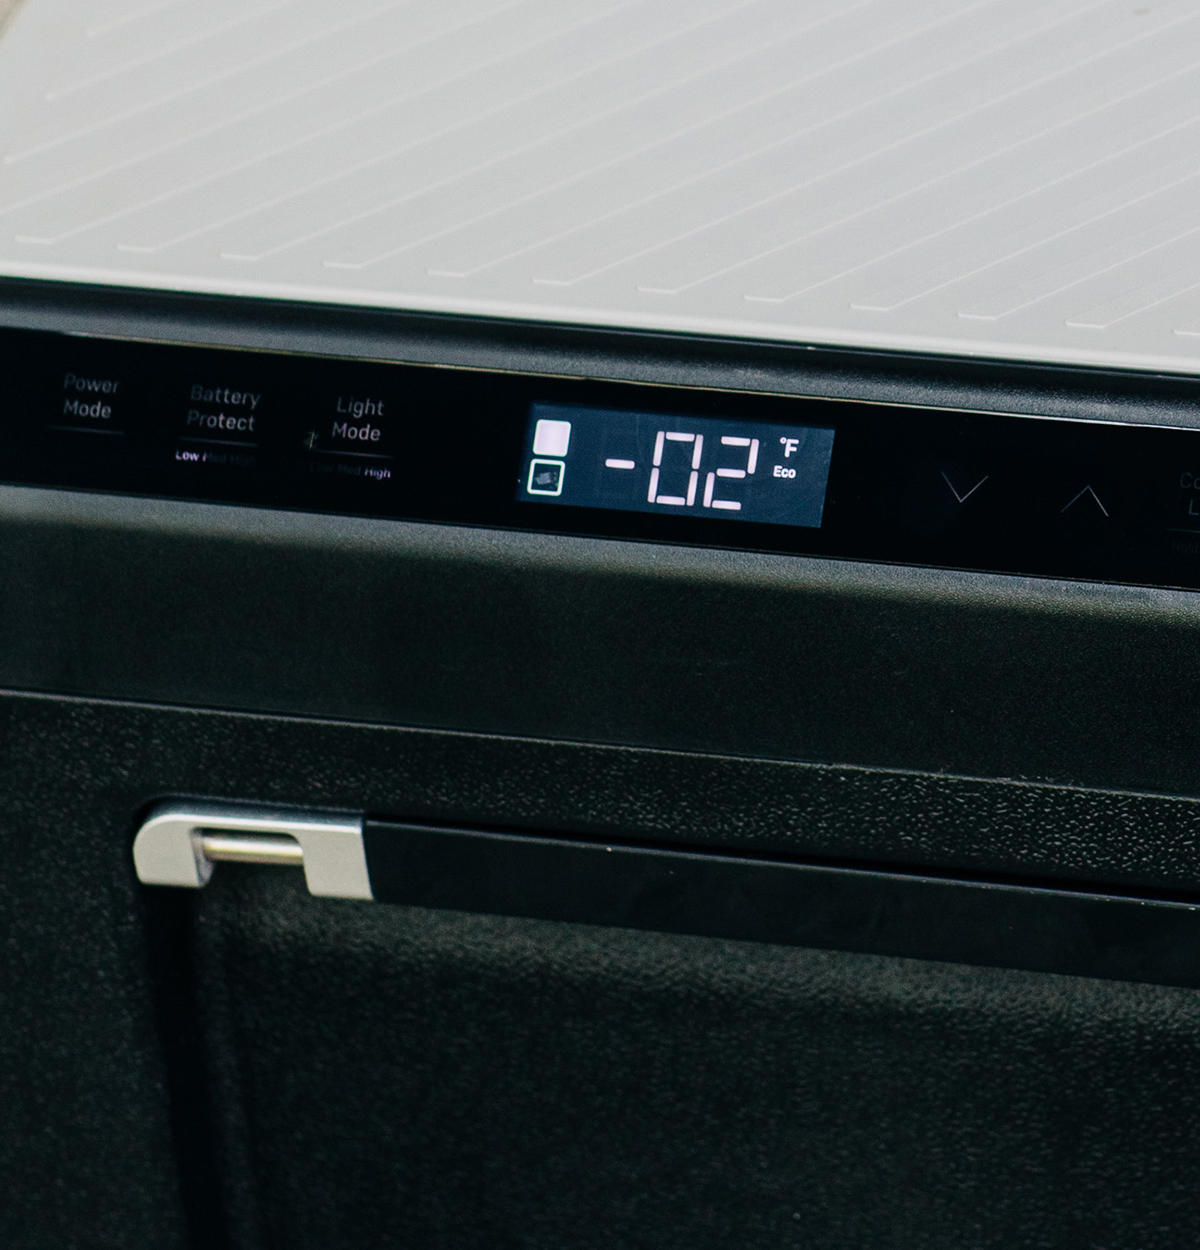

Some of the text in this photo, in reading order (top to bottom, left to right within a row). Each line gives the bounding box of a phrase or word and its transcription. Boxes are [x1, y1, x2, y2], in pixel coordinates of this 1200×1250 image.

[63, 372, 121, 394] Power
[190, 385, 261, 410] Battery
[336, 397, 385, 418] Light
[63, 398, 112, 420] Mode
[186, 410, 256, 432] Protect
[331, 422, 381, 442] Mode
[175, 449, 201, 463] Low
[364, 467, 391, 481] High
[773, 465, 797, 479] Eco
